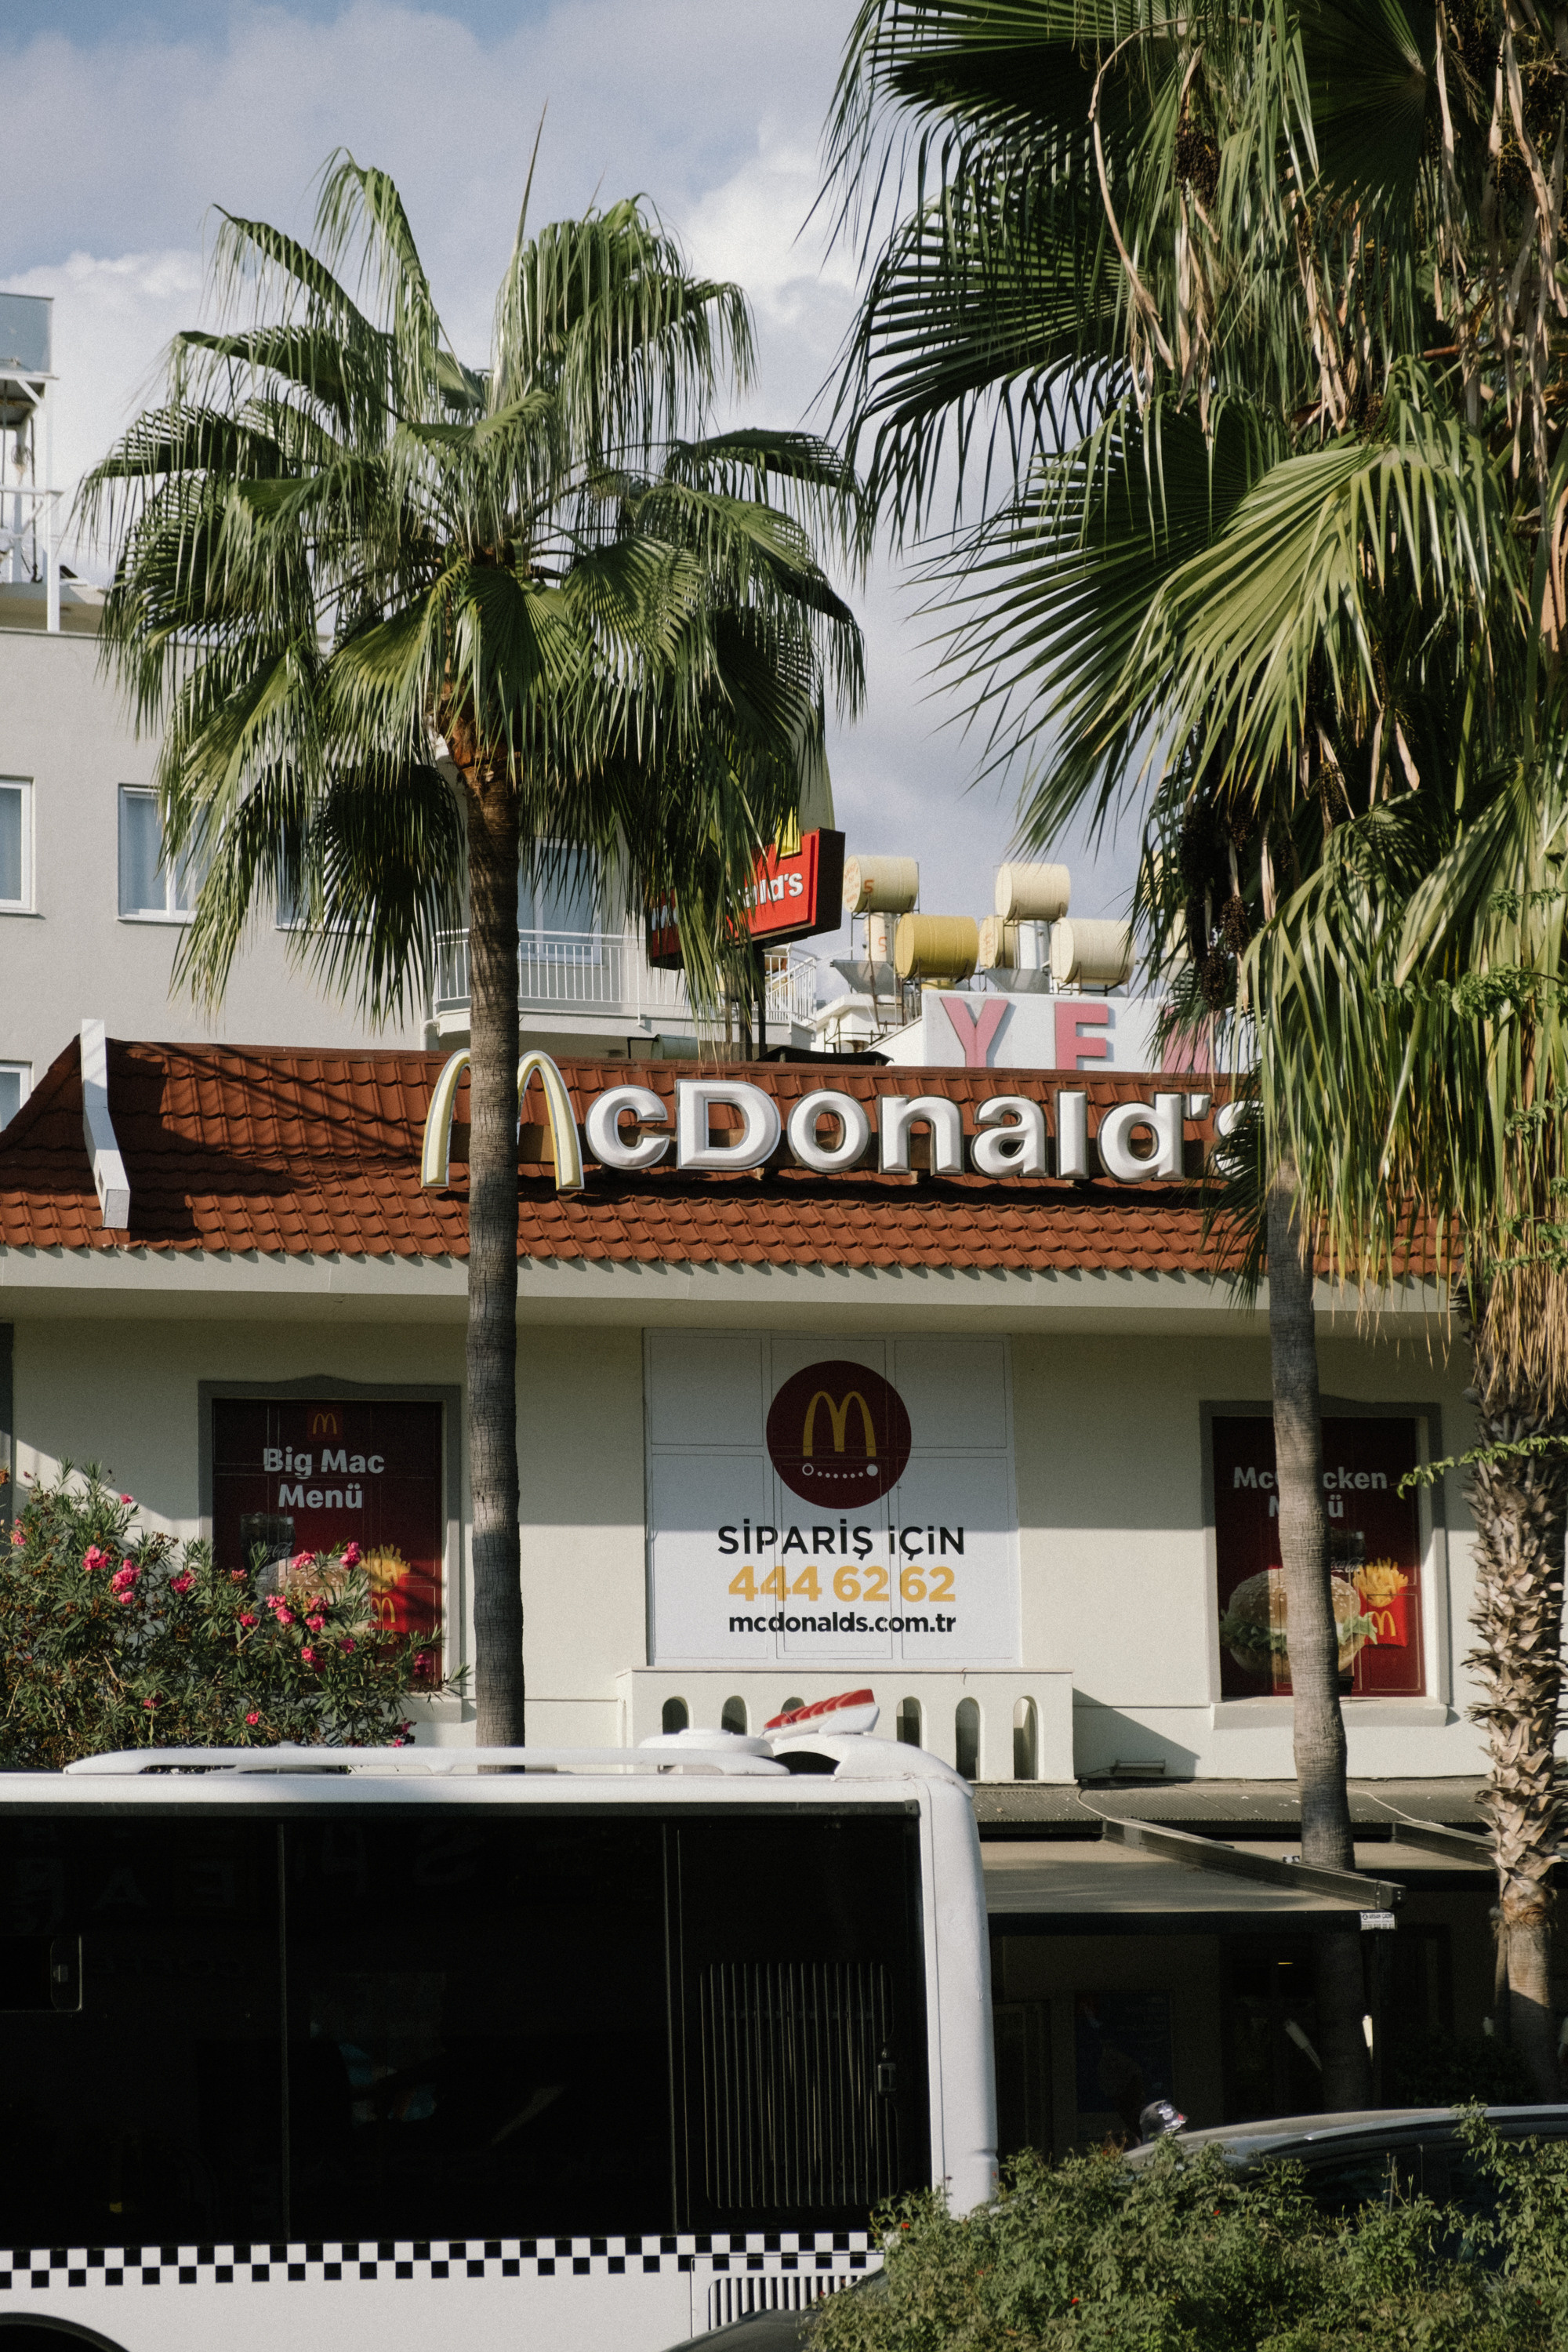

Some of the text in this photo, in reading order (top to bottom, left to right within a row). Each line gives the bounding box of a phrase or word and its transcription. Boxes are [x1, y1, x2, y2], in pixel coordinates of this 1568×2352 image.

[263, 1446, 385, 1479] Big Mac
[1233, 1466, 1388, 1490] Mccken
[278, 1483, 363, 1509] Menü
[717, 1518, 873, 1561] SİPARİŞ
[728, 1566, 956, 1602] 444 62 62
[729, 1612, 956, 1632] mcdonalds.com.tr
